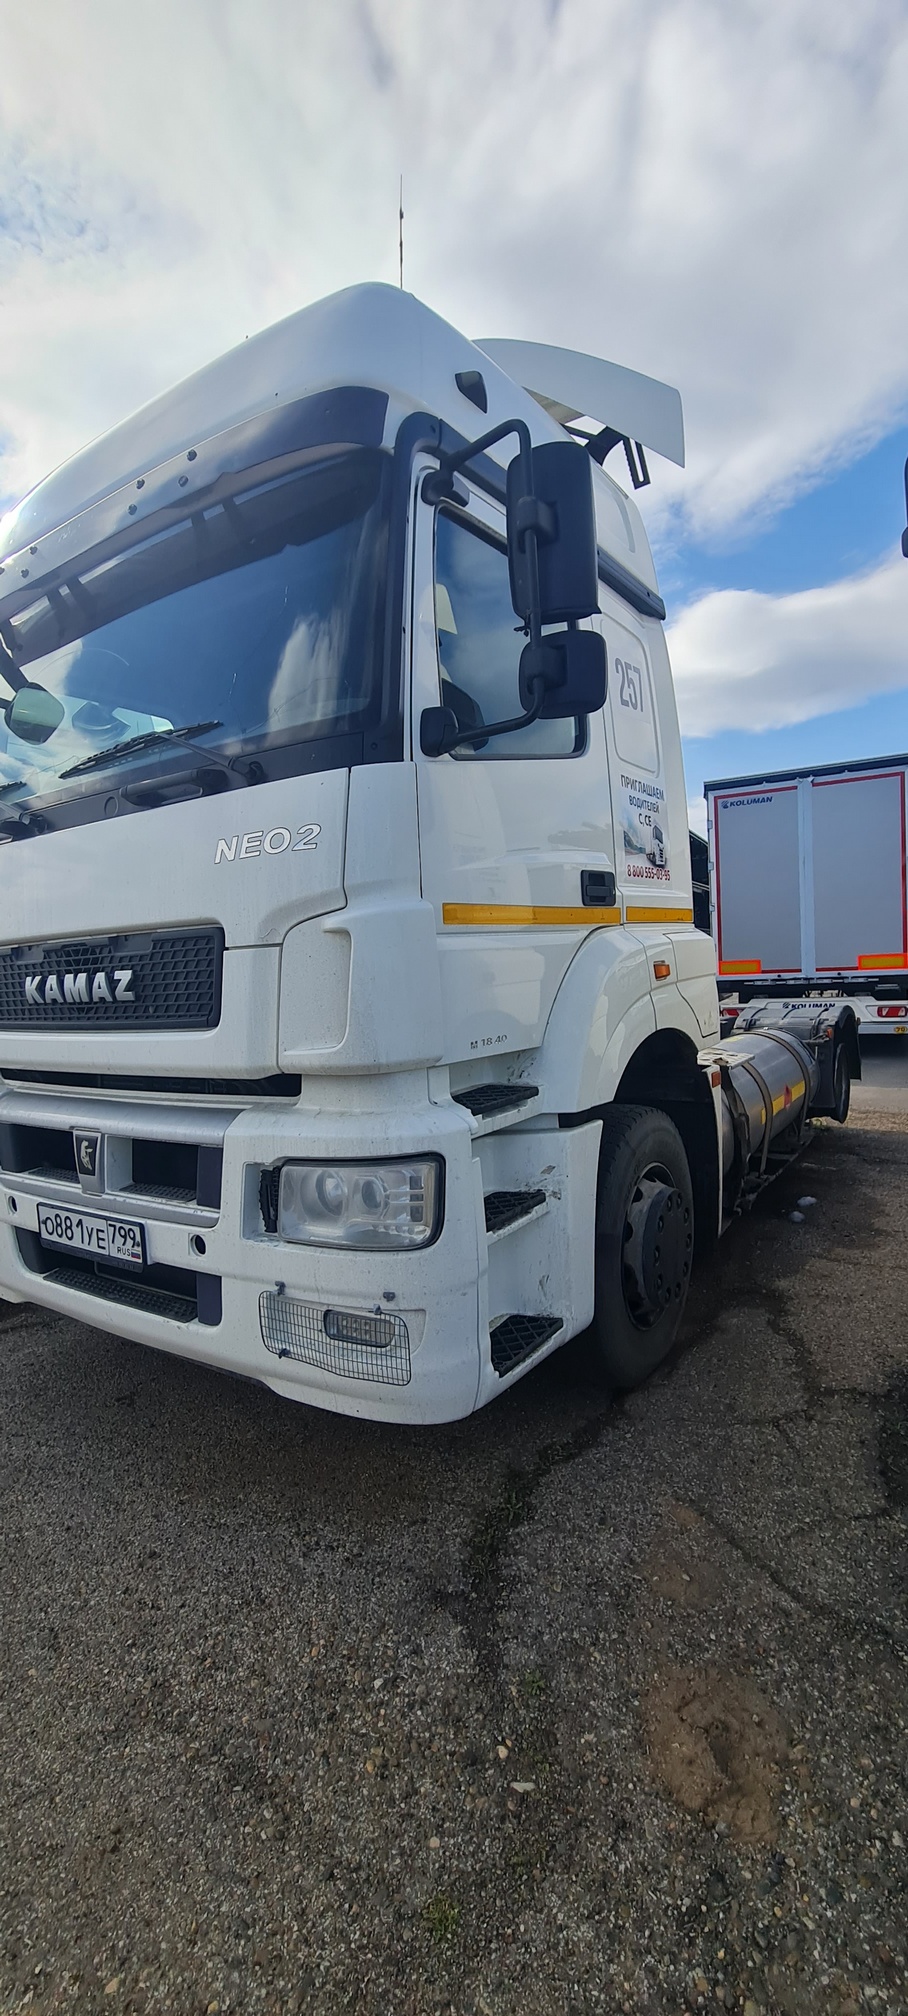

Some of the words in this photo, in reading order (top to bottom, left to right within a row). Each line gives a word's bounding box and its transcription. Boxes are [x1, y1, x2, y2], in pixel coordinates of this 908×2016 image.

[615, 657, 644, 713] 257
[621, 774, 665, 802] ПРИГЛАШАЕМ
[628, 794, 660, 814] ВОДИТЕЛЕЙ
[729, 796, 773, 808] KOLUMAN
[212, 822, 322, 865] NEO2
[23, 968, 136, 1005] KAMAZ
[108, 1222, 137, 1249] 799
[117, 1246, 131, 1257] RUS
